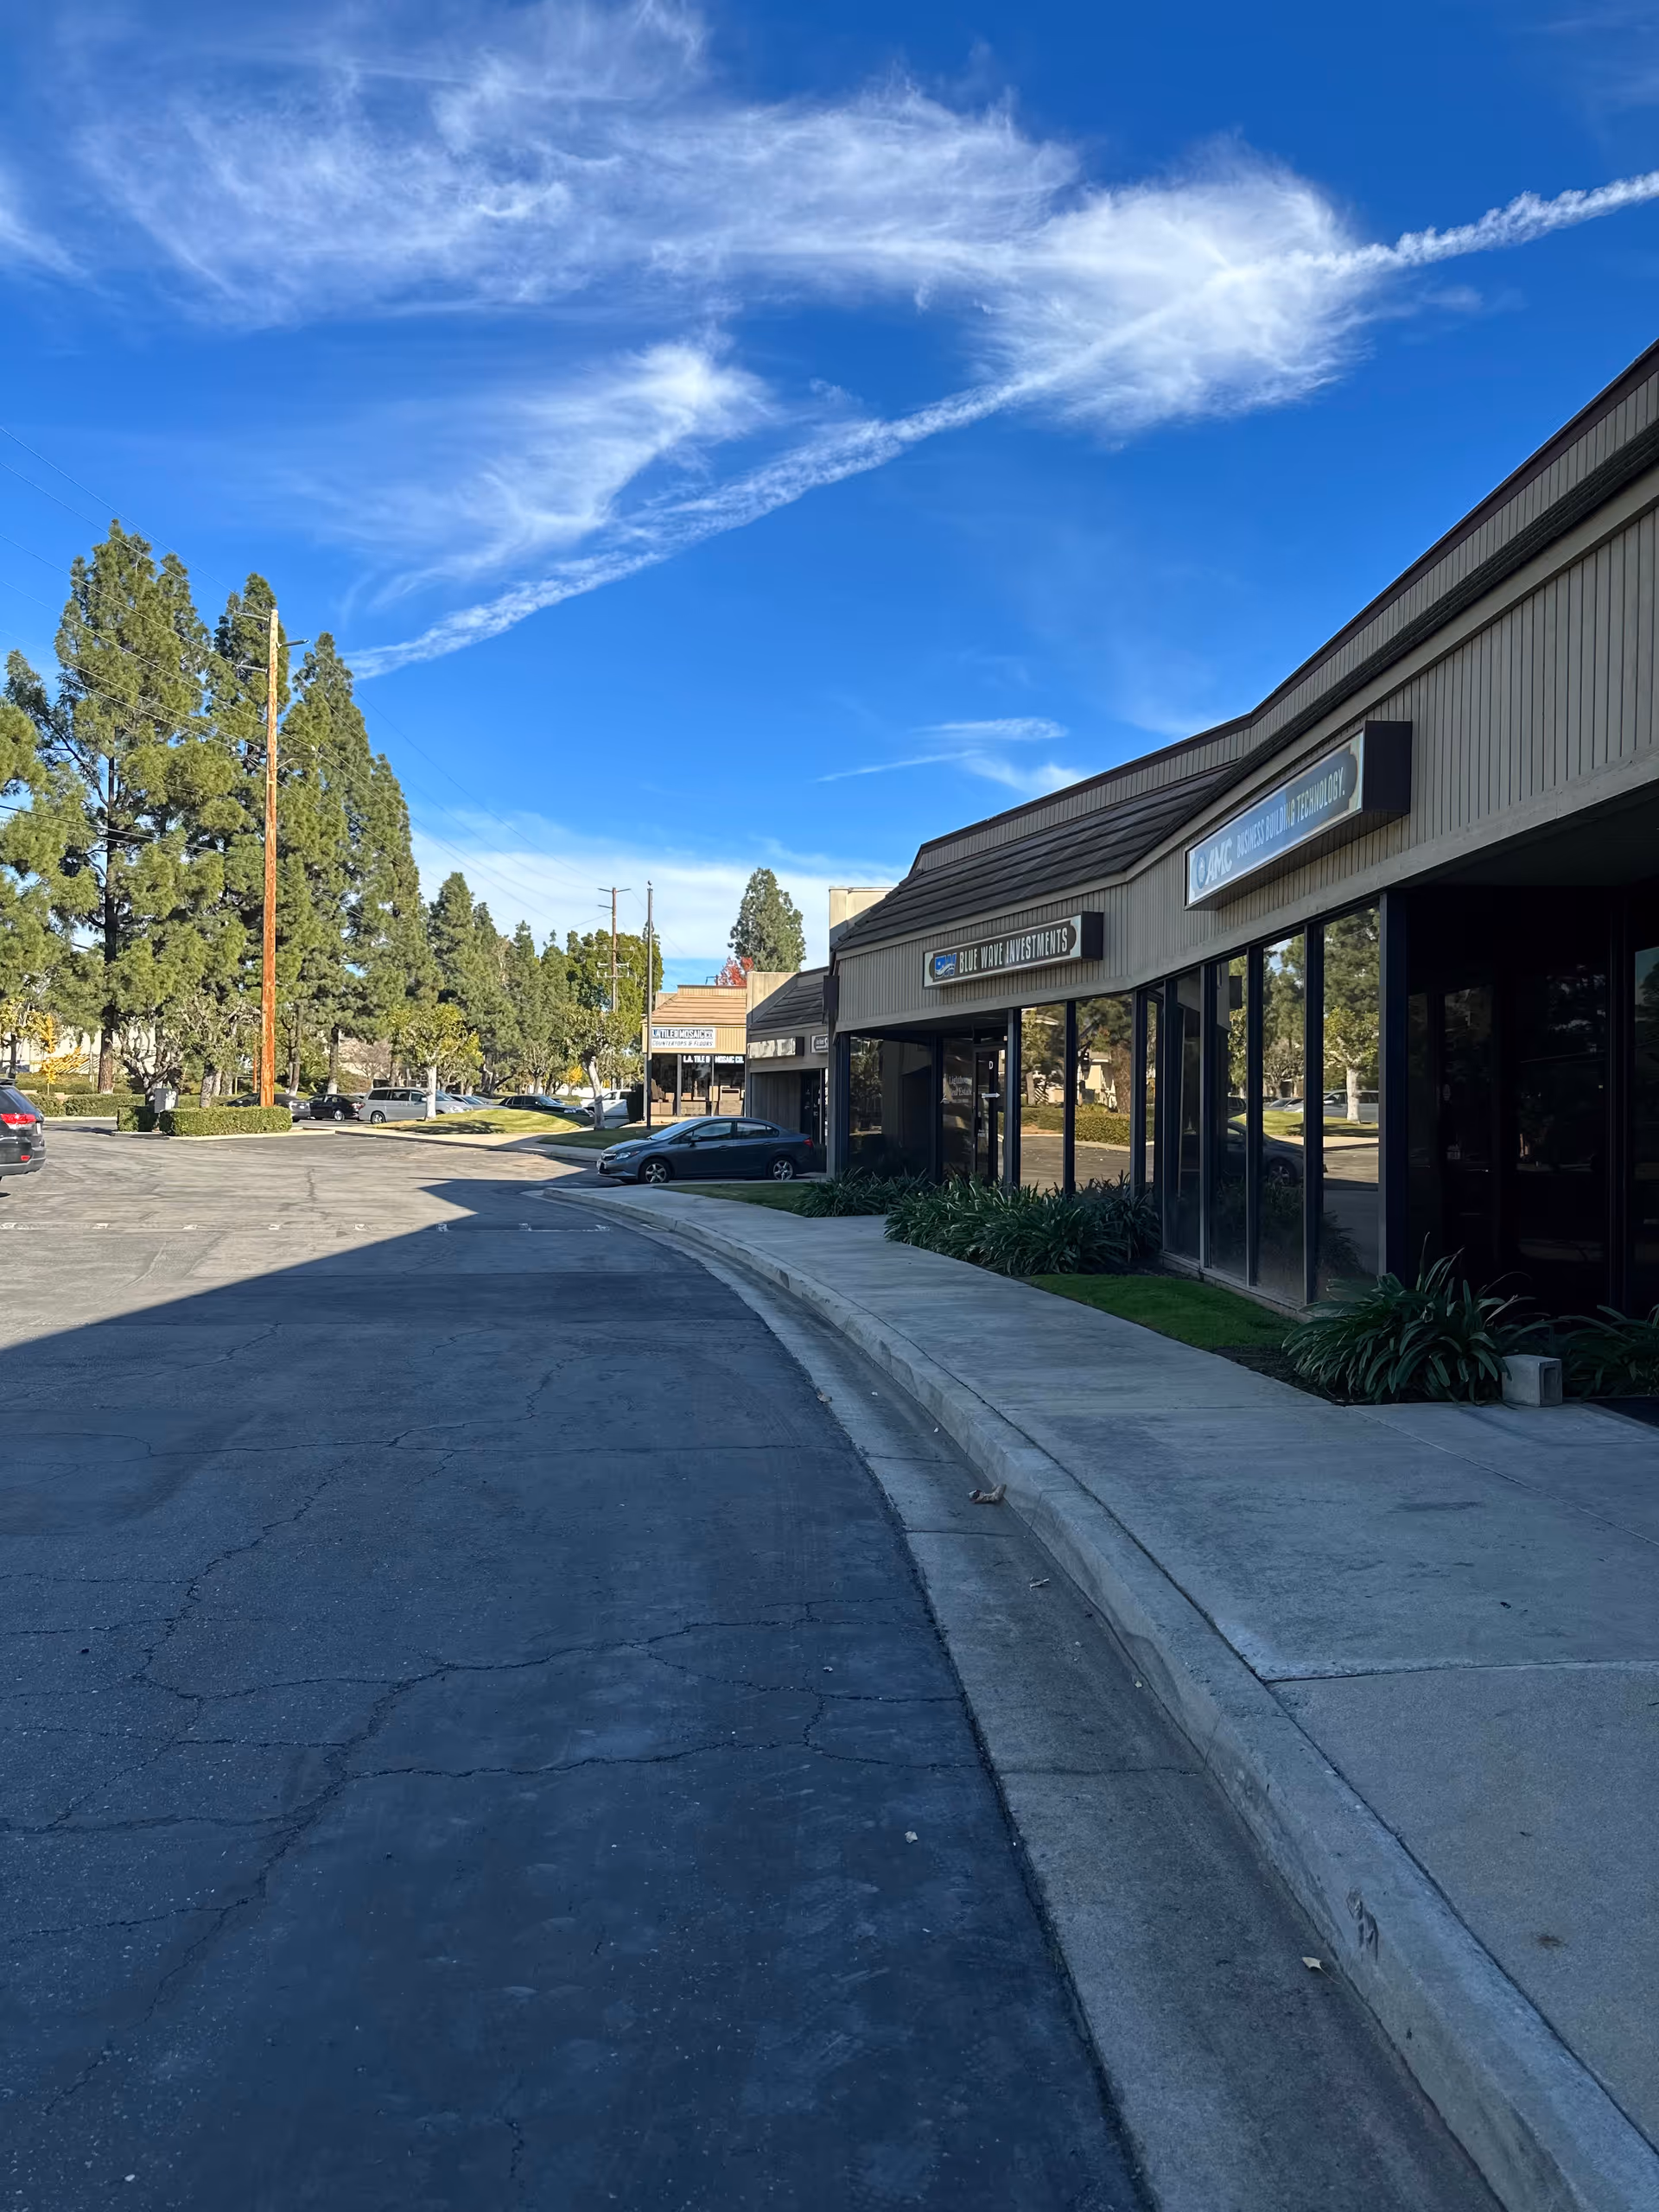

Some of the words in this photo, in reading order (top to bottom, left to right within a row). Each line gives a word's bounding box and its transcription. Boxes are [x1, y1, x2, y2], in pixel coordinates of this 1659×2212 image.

[1205, 837, 1232, 885] AMC
[1236, 817, 1265, 858] BUSINESS
[1265, 798, 1294, 842] BUILDING
[959, 948, 977, 974] BLUE
[981, 942, 1003, 969] WAVE
[1006, 927, 1068, 963] INVESTMENTS
[660, 1029, 674, 1039] TILE
[679, 1029, 704, 1039] MOSAIC
[988, 1060, 994, 1069] D
